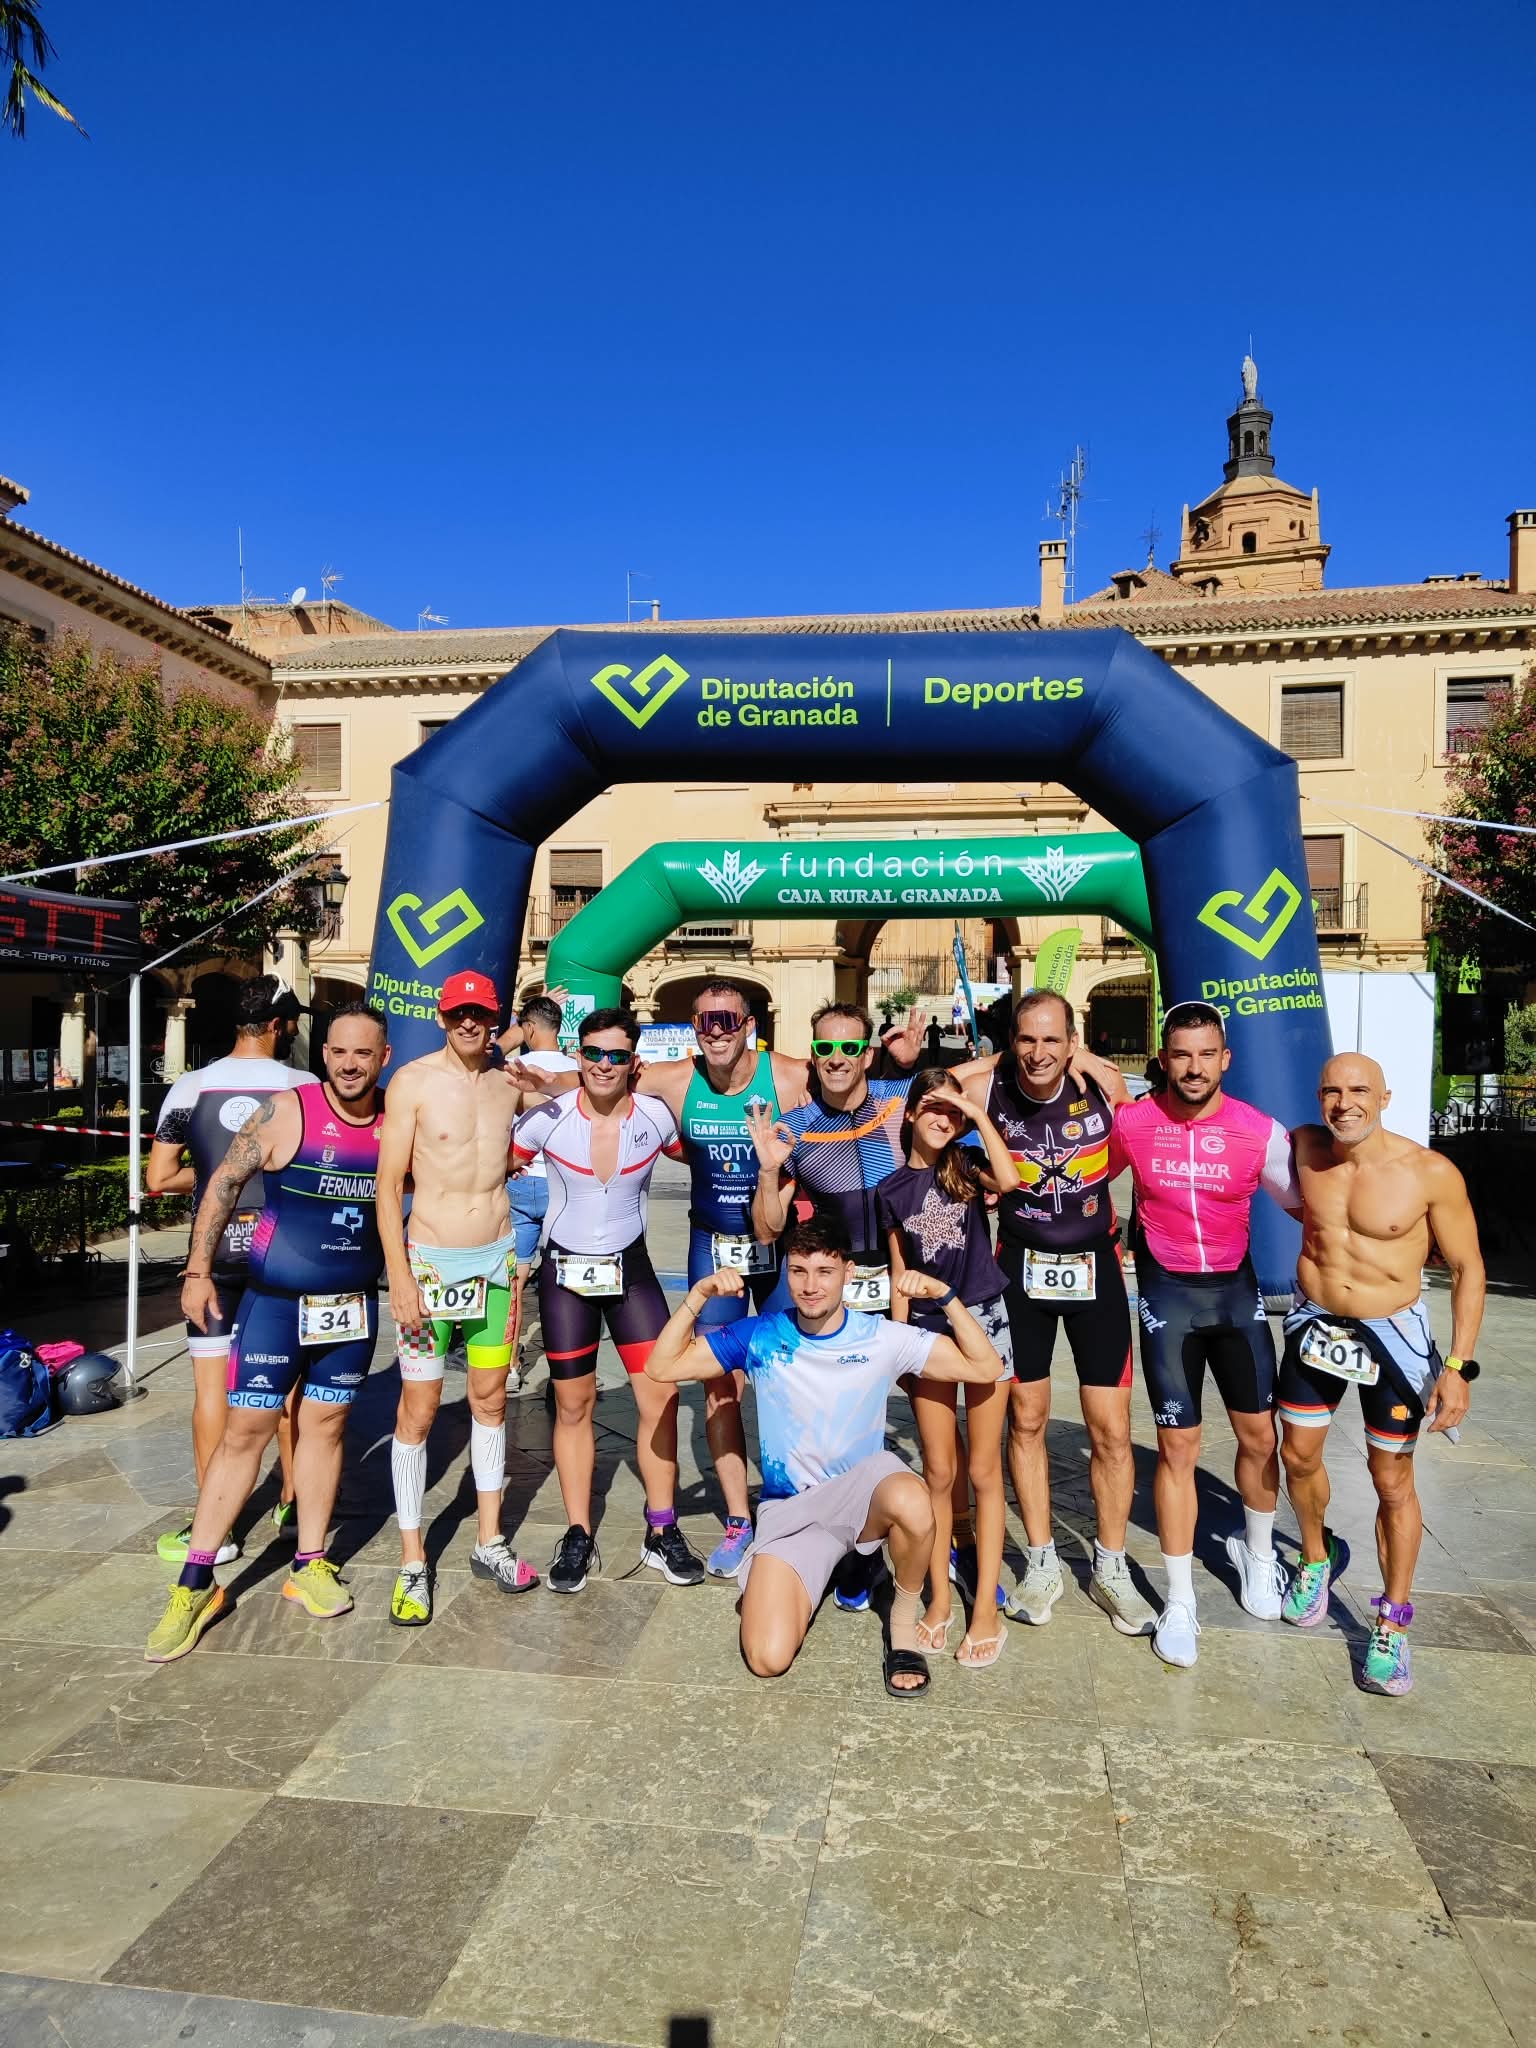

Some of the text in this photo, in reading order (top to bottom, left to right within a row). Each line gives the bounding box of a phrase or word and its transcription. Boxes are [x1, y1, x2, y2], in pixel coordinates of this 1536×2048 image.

[701, 676, 854, 704] Diputación
[924, 676, 1084, 710] Deportes
[697, 703, 859, 727] de Granada
[780, 850, 1003, 878] fundación
[778, 888, 1003, 904] CAJA RURAL GRANADA
[73, 956, 111, 968] TIMING
[1054, 944, 1075, 992] Granada
[1201, 968, 1319, 1000] Diputación
[1236, 990, 1324, 1016] Granada
[692, 1123, 719, 1135] SAN
[1155, 1126, 1182, 1135] ABB
[707, 1143, 754, 1161] ROTY
[730, 1246, 760, 1265] 54
[582, 1266, 598, 1284] 4
[1044, 1269, 1076, 1289] 80
[429, 1287, 476, 1308] 109
[851, 1280, 881, 1299] 78
[319, 1309, 351, 1331] 34
[1317, 1339, 1363, 1369] 101
